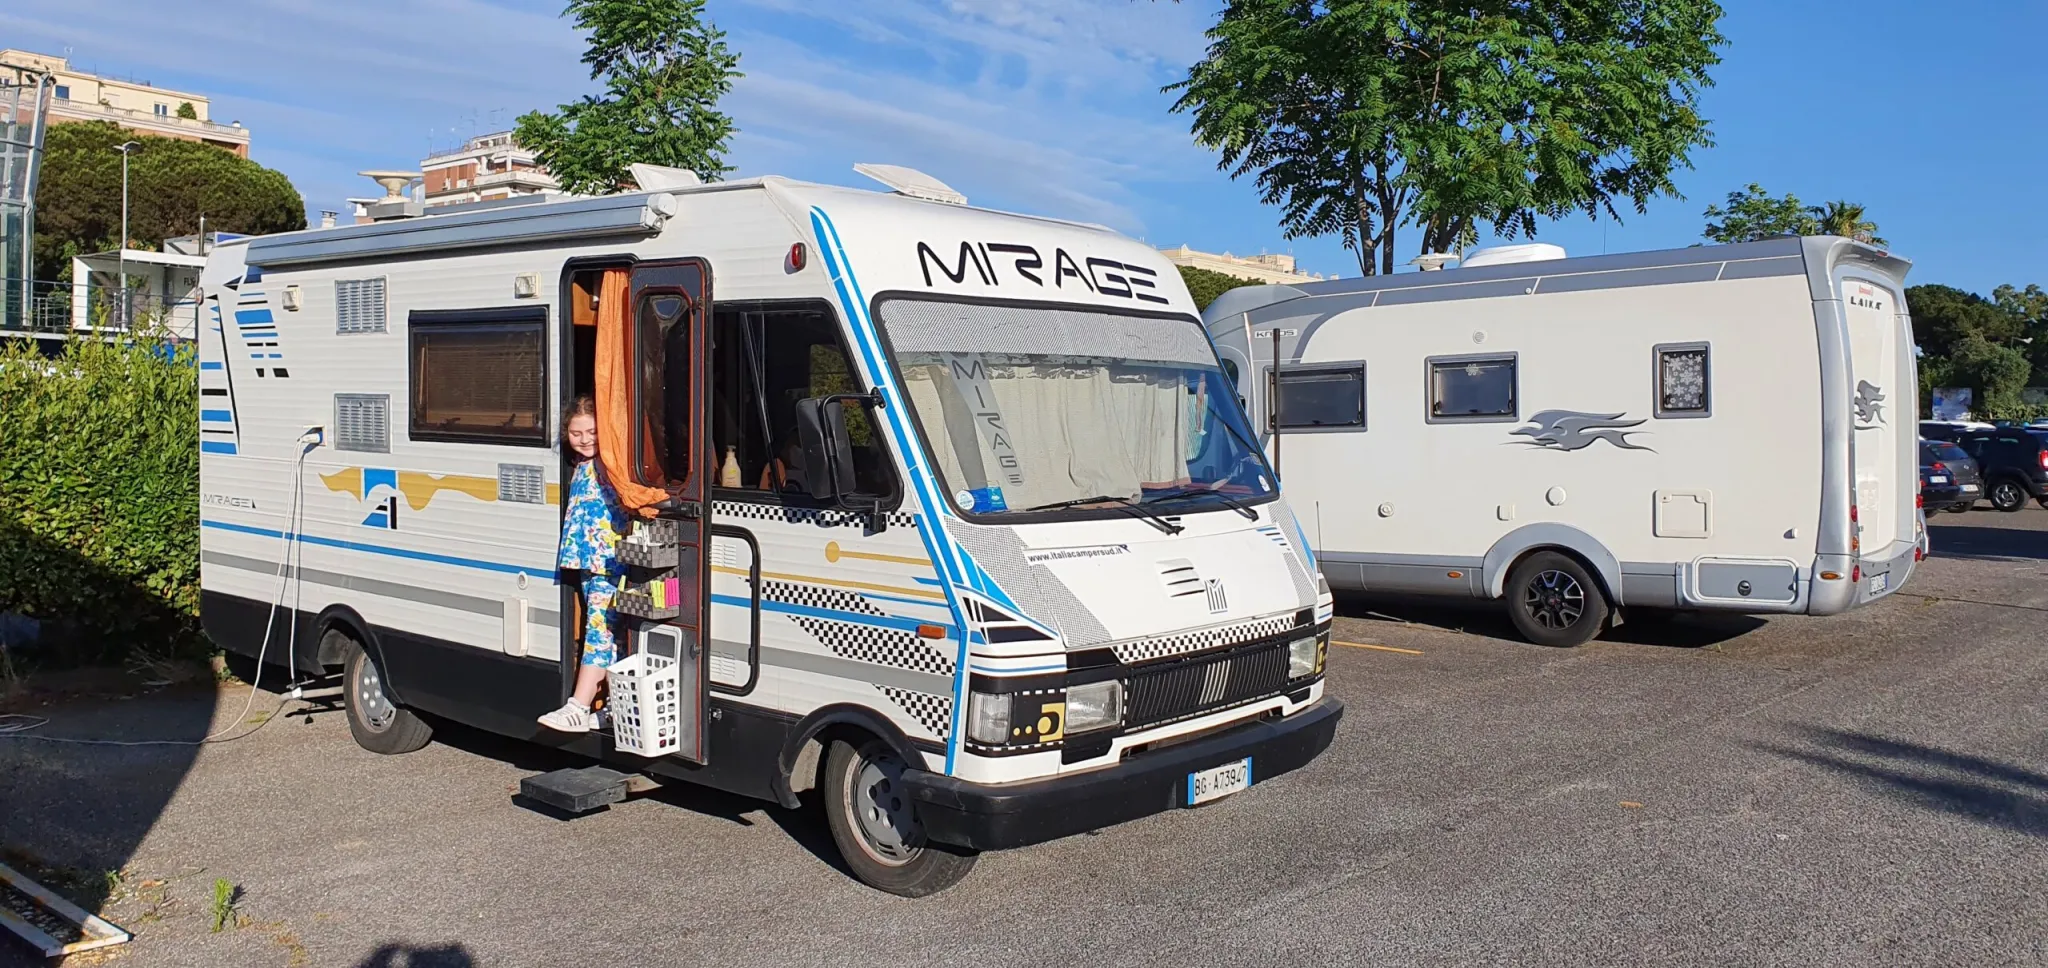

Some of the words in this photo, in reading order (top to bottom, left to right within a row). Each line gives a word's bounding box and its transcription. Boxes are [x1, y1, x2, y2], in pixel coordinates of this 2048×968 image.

[917, 241, 1170, 305] MIRAGE
[1850, 295, 1882, 310] LAIKA
[203, 493, 250, 509] MIRAGE
[1027, 547, 1123, 563] www.italiacampersud.it
